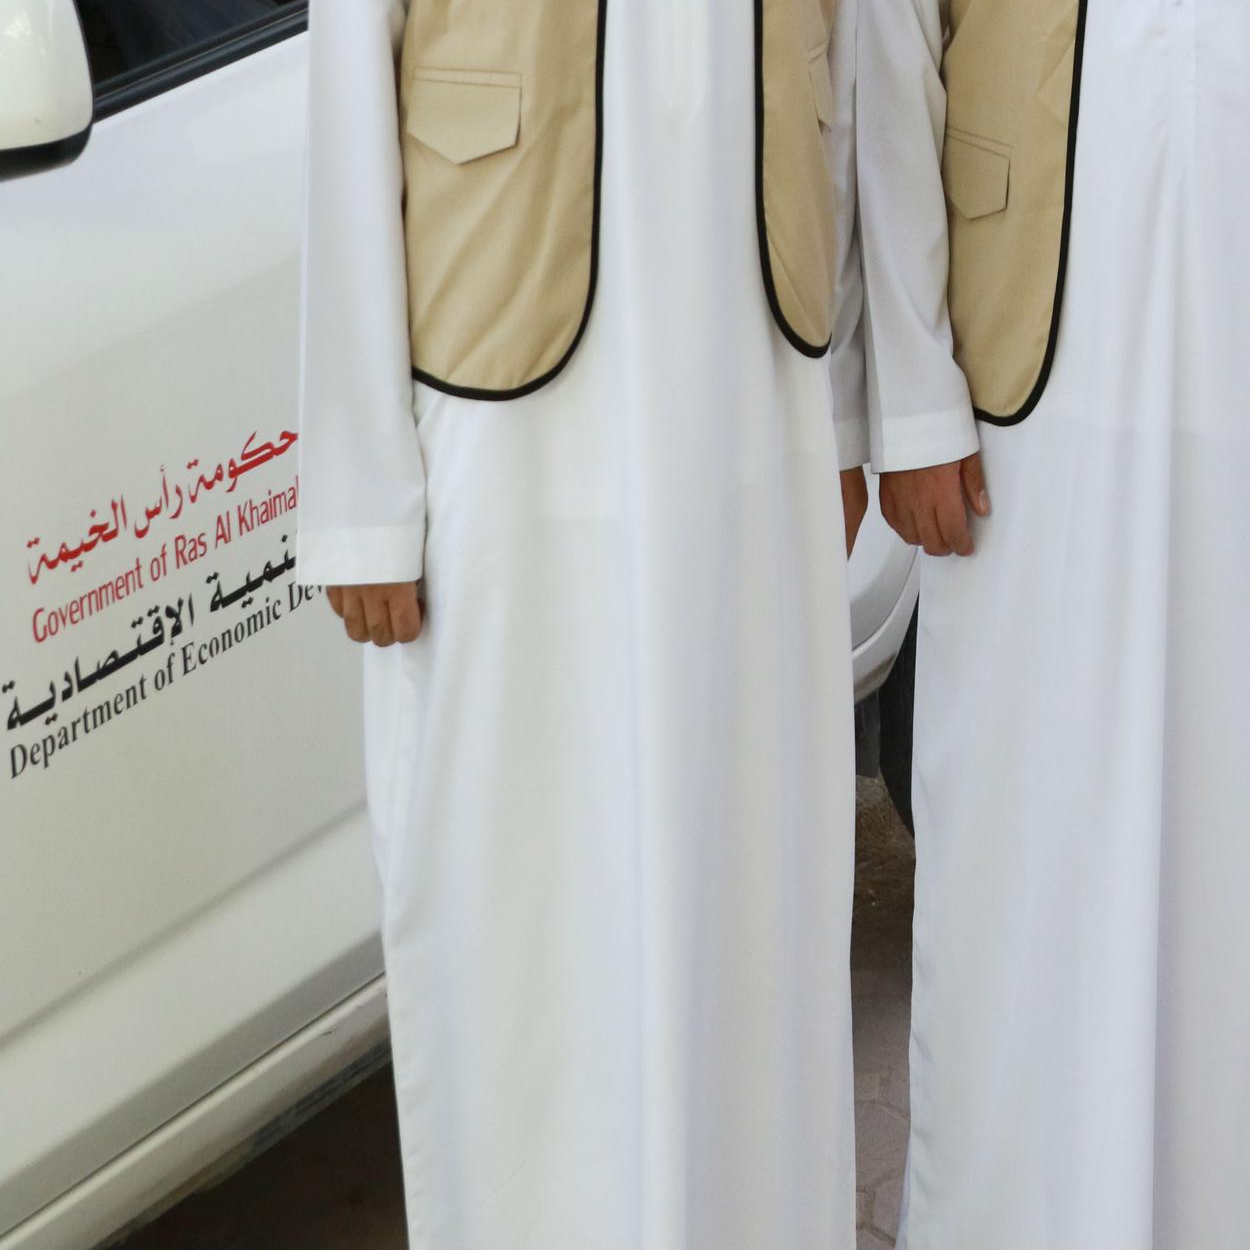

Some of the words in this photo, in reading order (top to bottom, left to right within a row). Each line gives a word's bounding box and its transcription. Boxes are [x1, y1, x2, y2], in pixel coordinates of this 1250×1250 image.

[134, 464, 183, 539] رأس
[186, 430, 298, 504] حكومة
[26, 494, 128, 585] الخيمة
[33, 558, 143, 643] Government
[150, 544, 168, 582] of
[174, 531, 207, 570] Ras
[214, 514, 232, 549] Al
[10, 674, 147, 779] Department
[154, 652, 175, 692] of
[181, 596, 282, 676] Economic
